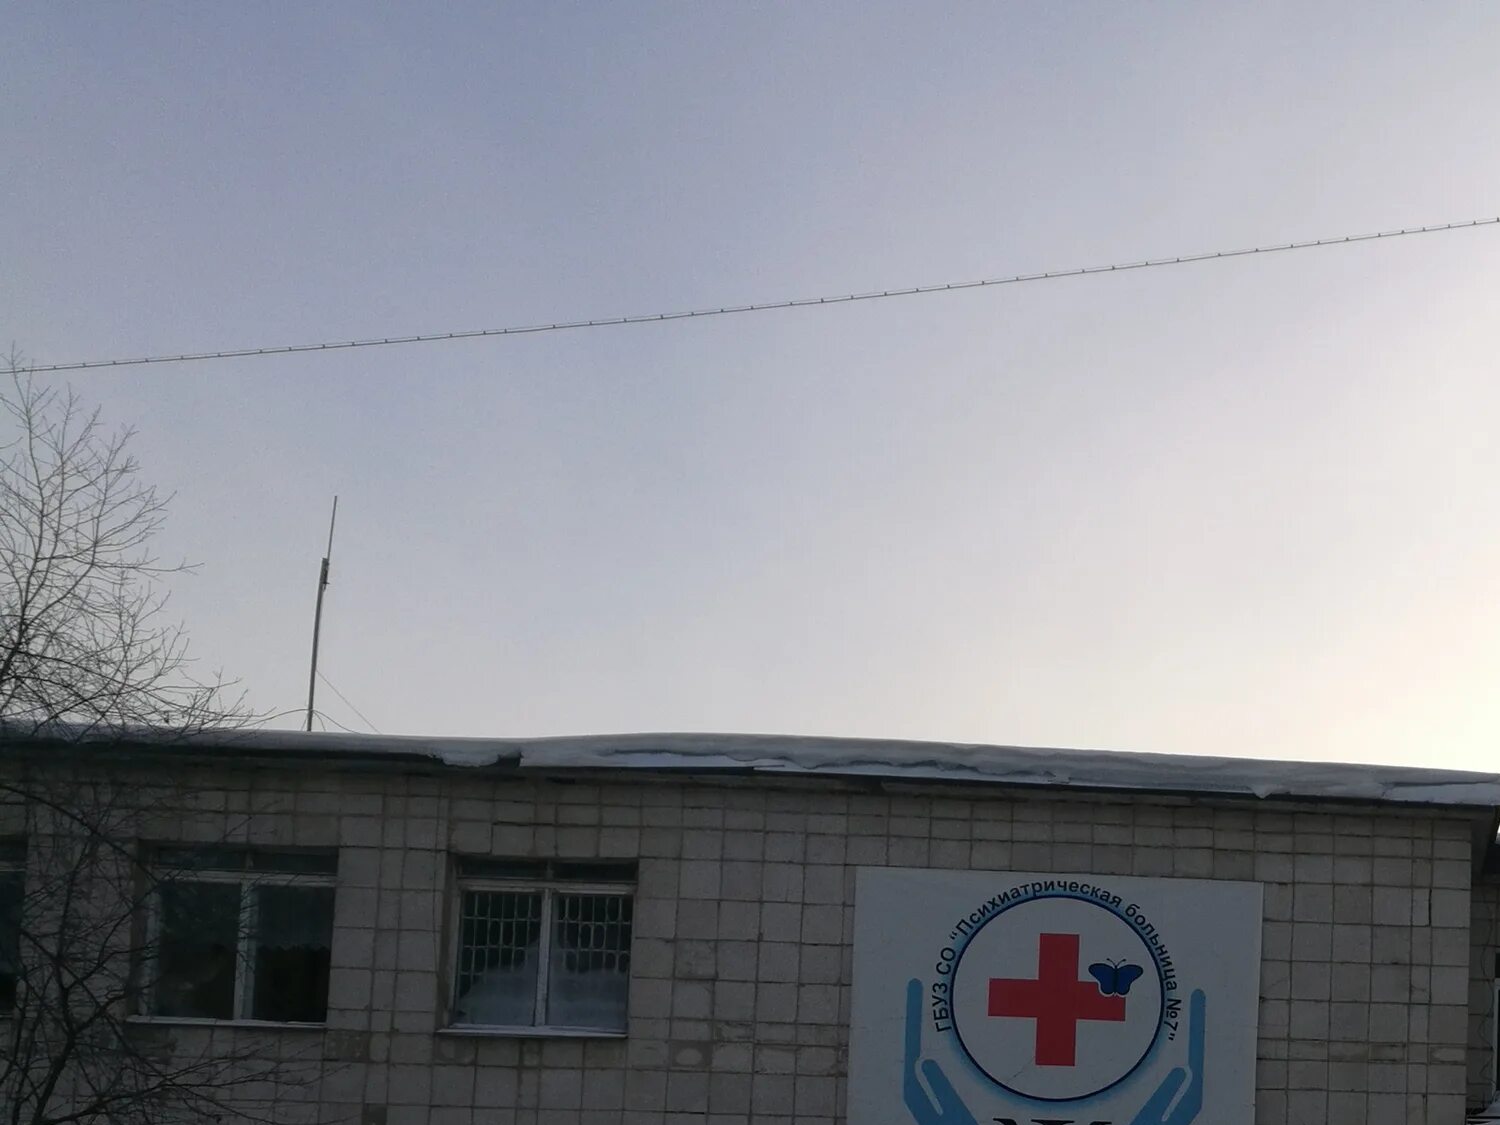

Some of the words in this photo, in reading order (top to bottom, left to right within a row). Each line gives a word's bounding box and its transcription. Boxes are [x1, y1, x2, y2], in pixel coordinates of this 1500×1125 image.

[935, 946, 957, 975] СО
[1124, 903, 1178, 992] больница
[931, 982, 952, 1032] ГБУЗ
